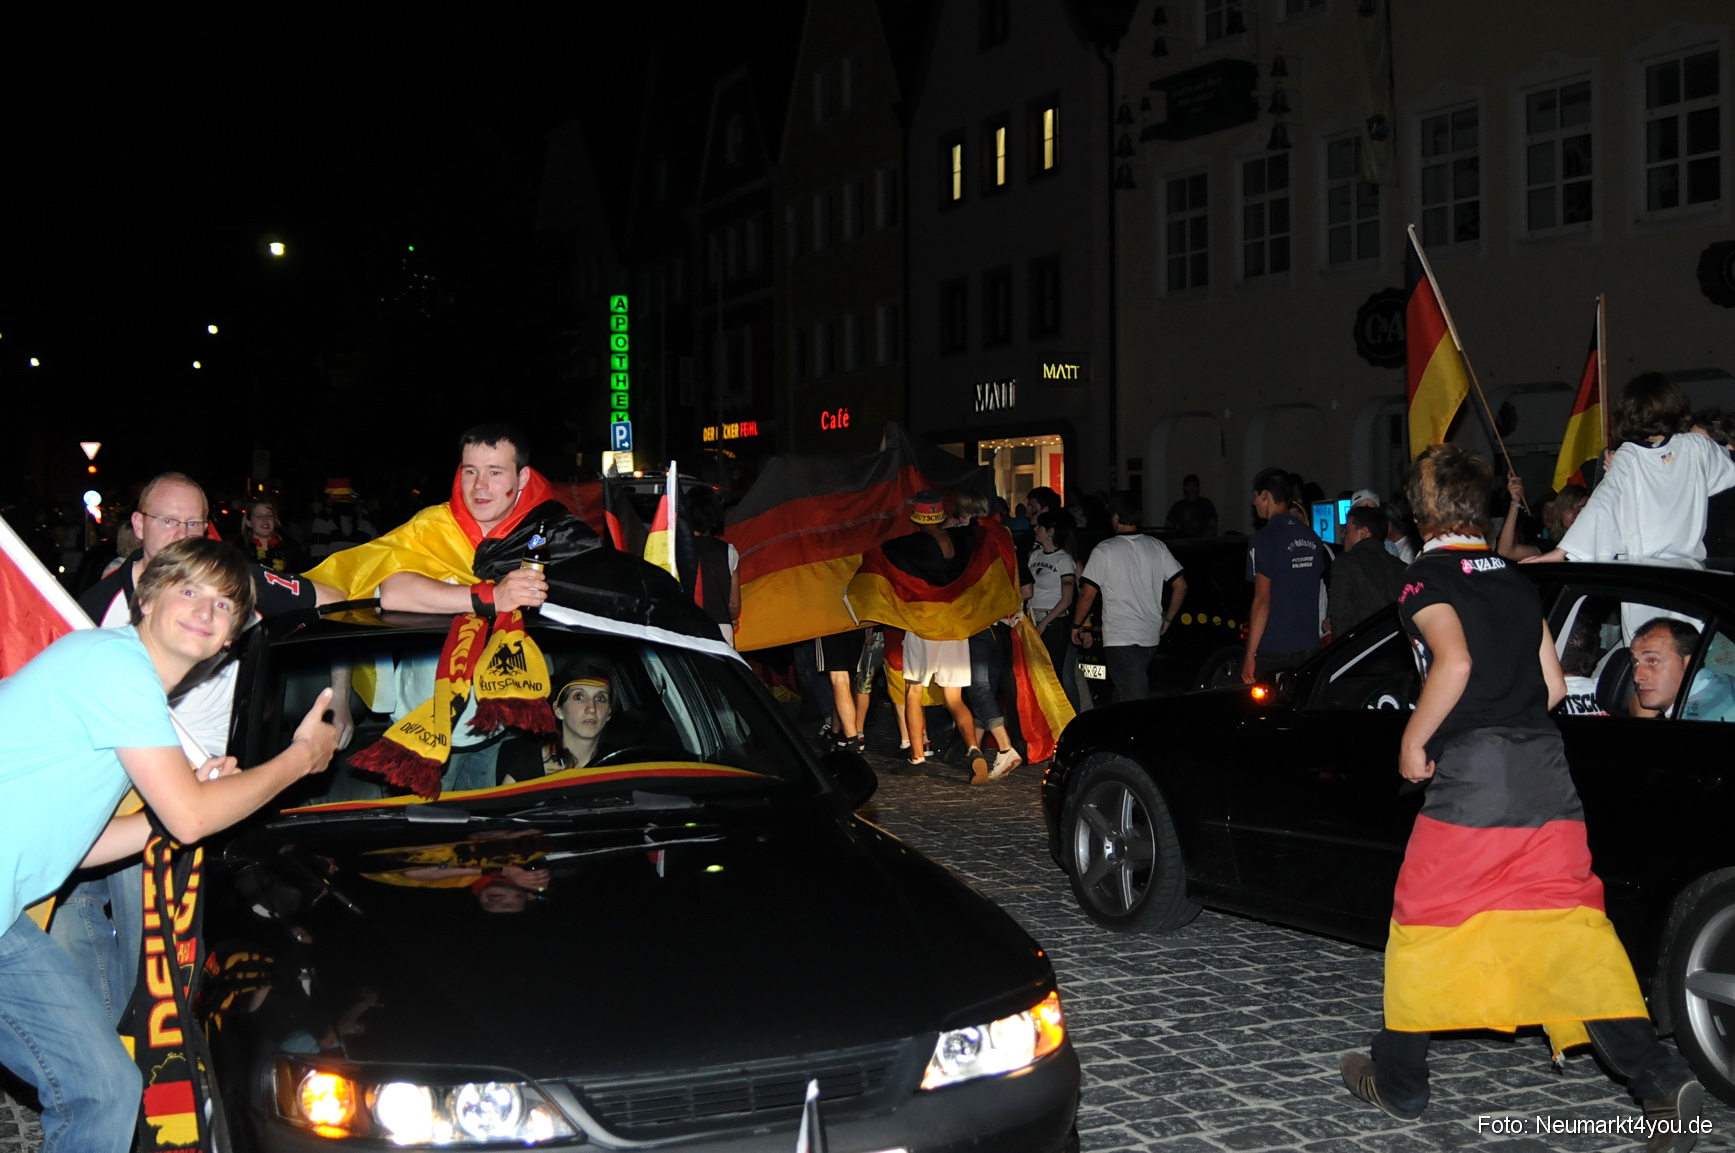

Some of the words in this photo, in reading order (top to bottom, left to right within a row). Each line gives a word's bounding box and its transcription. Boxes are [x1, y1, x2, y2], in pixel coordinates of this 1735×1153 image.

[1364, 309, 1405, 345] C&A
[1043, 363, 1081, 380] MATT
[975, 379, 1016, 412] MATT
[820, 408, 851, 431] Café
[615, 425, 628, 449] P
[1320, 518, 1328, 539] P
